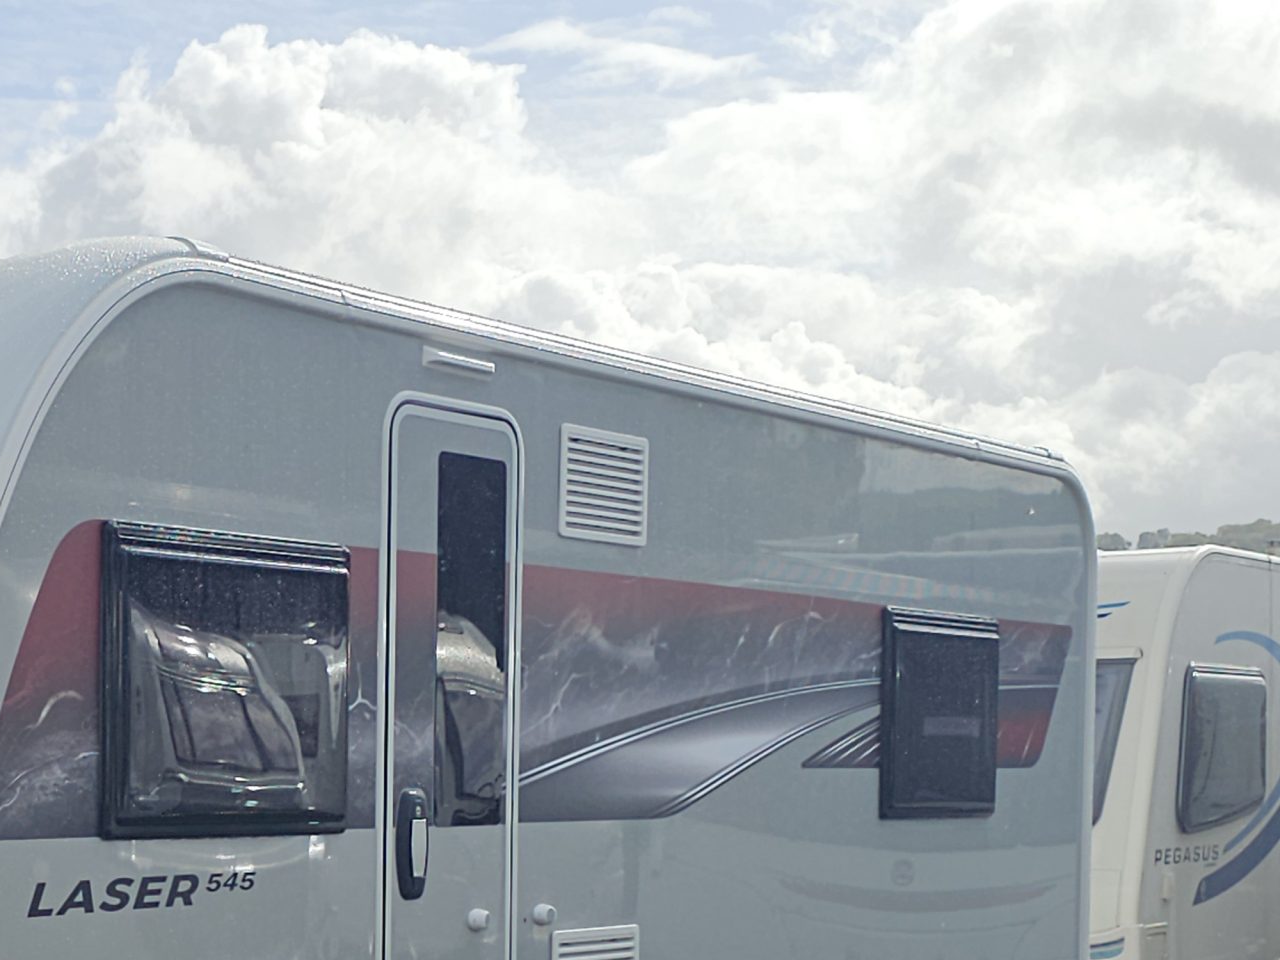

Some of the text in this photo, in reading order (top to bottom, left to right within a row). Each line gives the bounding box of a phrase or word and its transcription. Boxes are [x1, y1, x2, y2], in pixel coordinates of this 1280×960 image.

[1153, 844, 1220, 866] PEGASUS
[27, 871, 256, 918] LASER 545
